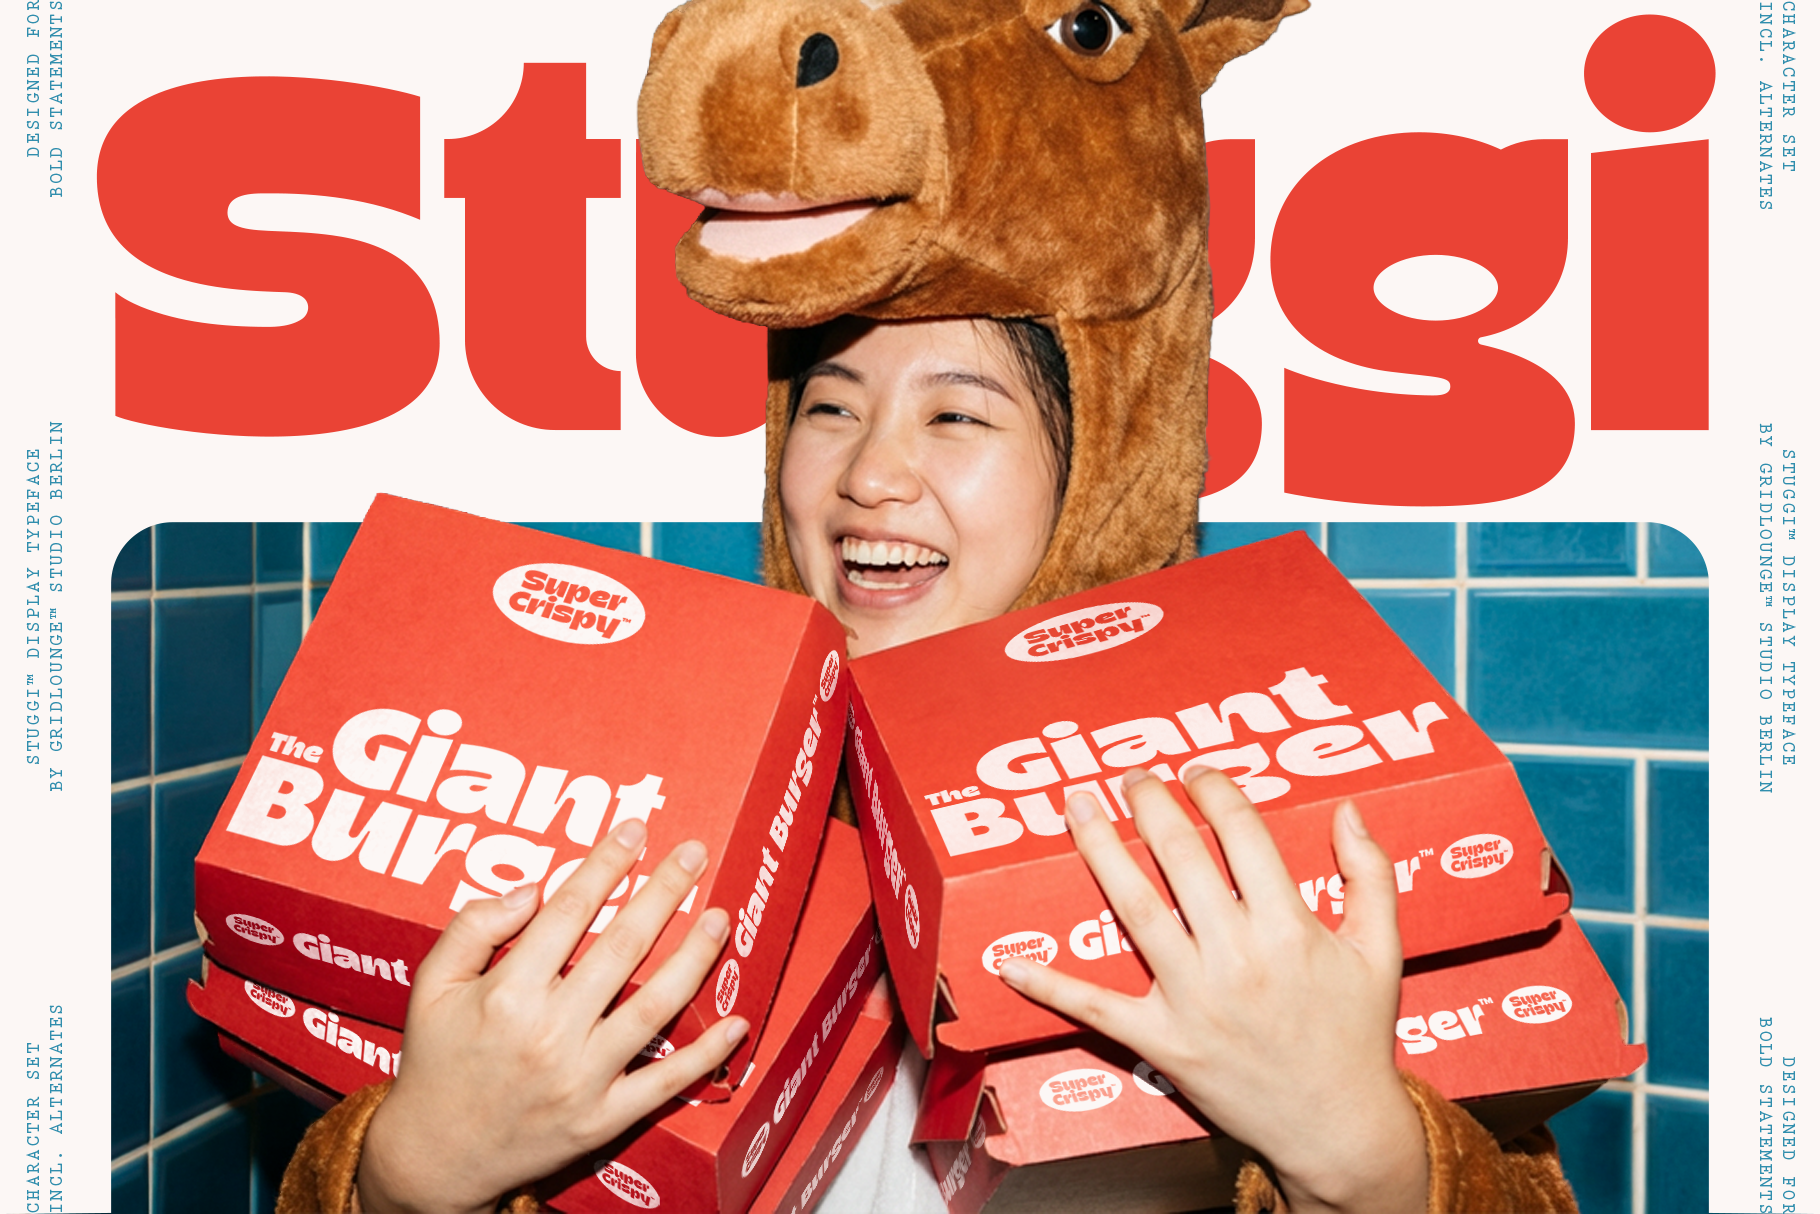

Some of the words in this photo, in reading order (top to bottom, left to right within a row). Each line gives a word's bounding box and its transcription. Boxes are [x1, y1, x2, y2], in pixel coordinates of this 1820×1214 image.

[521, 570, 628, 611] Super
[1023, 606, 1132, 644] Super
[269, 731, 324, 763] The
[924, 785, 981, 806] The
[976, 666, 1354, 791] Giant
[1450, 838, 1501, 859] Super
[735, 846, 779, 958] Giant
[233, 916, 275, 934] Super
[292, 932, 411, 987] Giant
[991, 937, 1045, 957] Super
[1508, 990, 1557, 1007] Super
[773, 1031, 820, 1125] Giant
[1048, 1074, 1106, 1093] Super
[604, 1164, 650, 1192] Super
